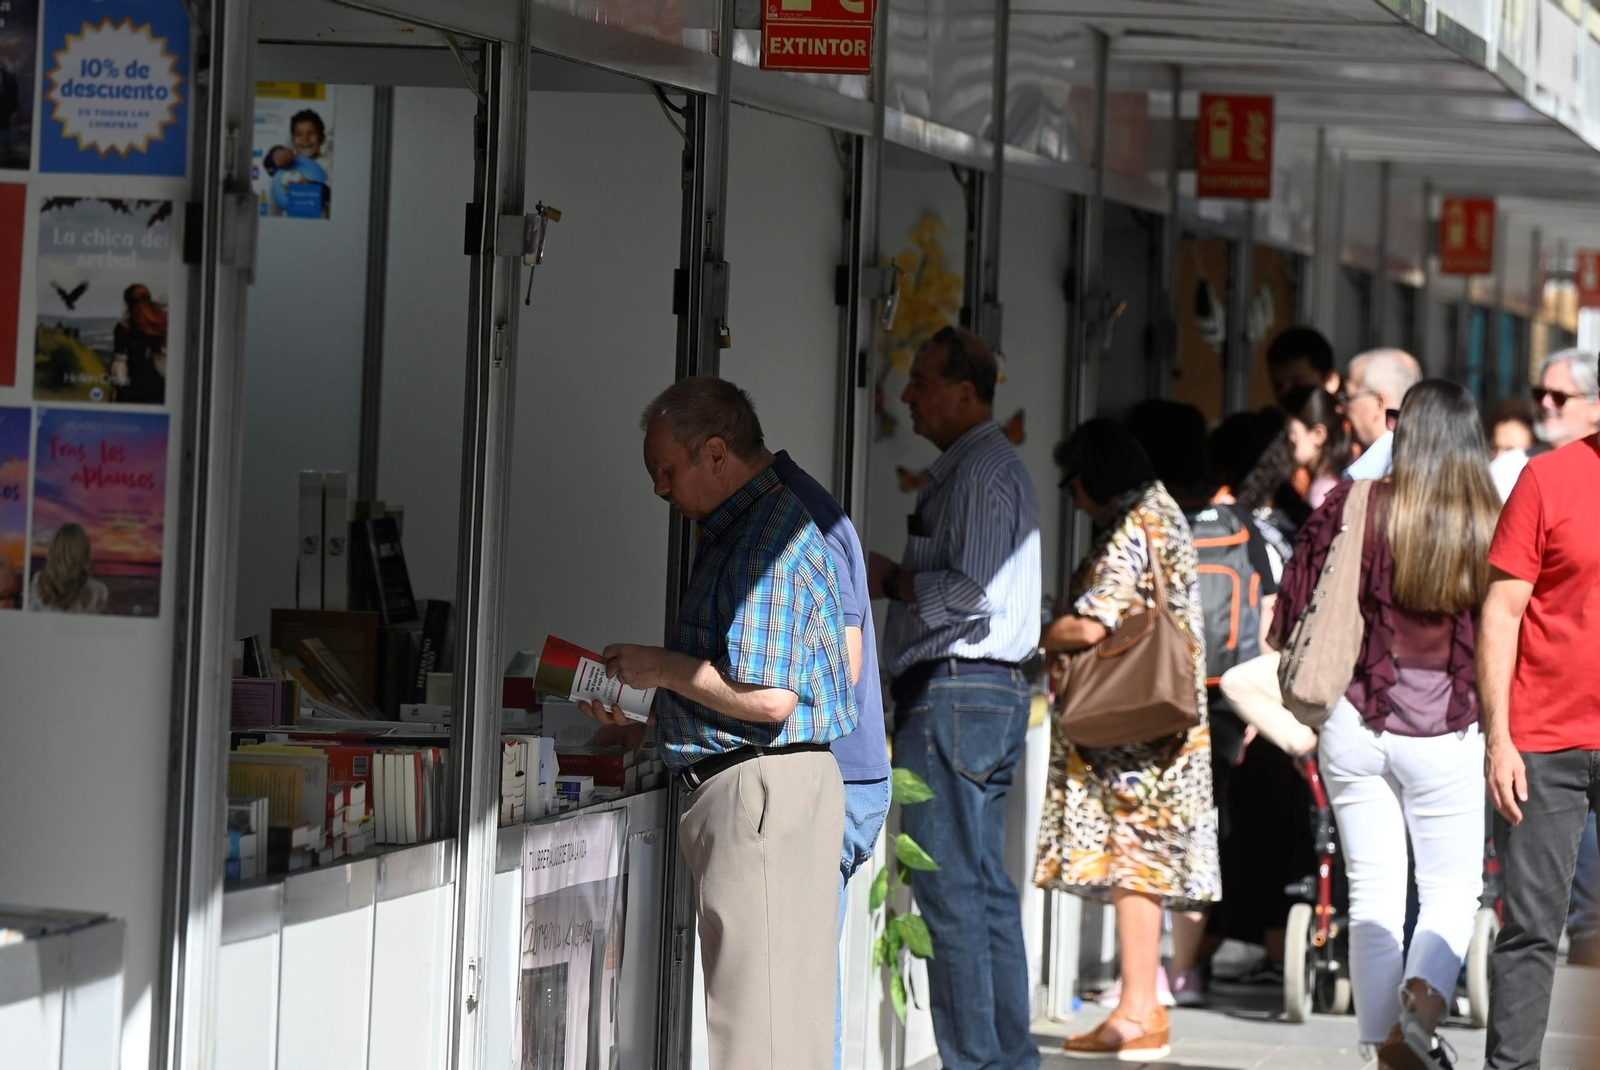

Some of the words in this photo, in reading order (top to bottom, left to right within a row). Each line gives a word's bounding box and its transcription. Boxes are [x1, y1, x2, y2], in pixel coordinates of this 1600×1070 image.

[769, 36, 867, 57] EXTINTOR
[80, 58, 119, 78] 10%
[125, 60, 150, 79] de
[60, 79, 168, 100] descuento
[53, 227, 75, 245] La
[82, 229, 134, 247] chica
[140, 229, 169, 248] del
[100, 438, 125, 463] los
[71, 464, 155, 490] aplausos
